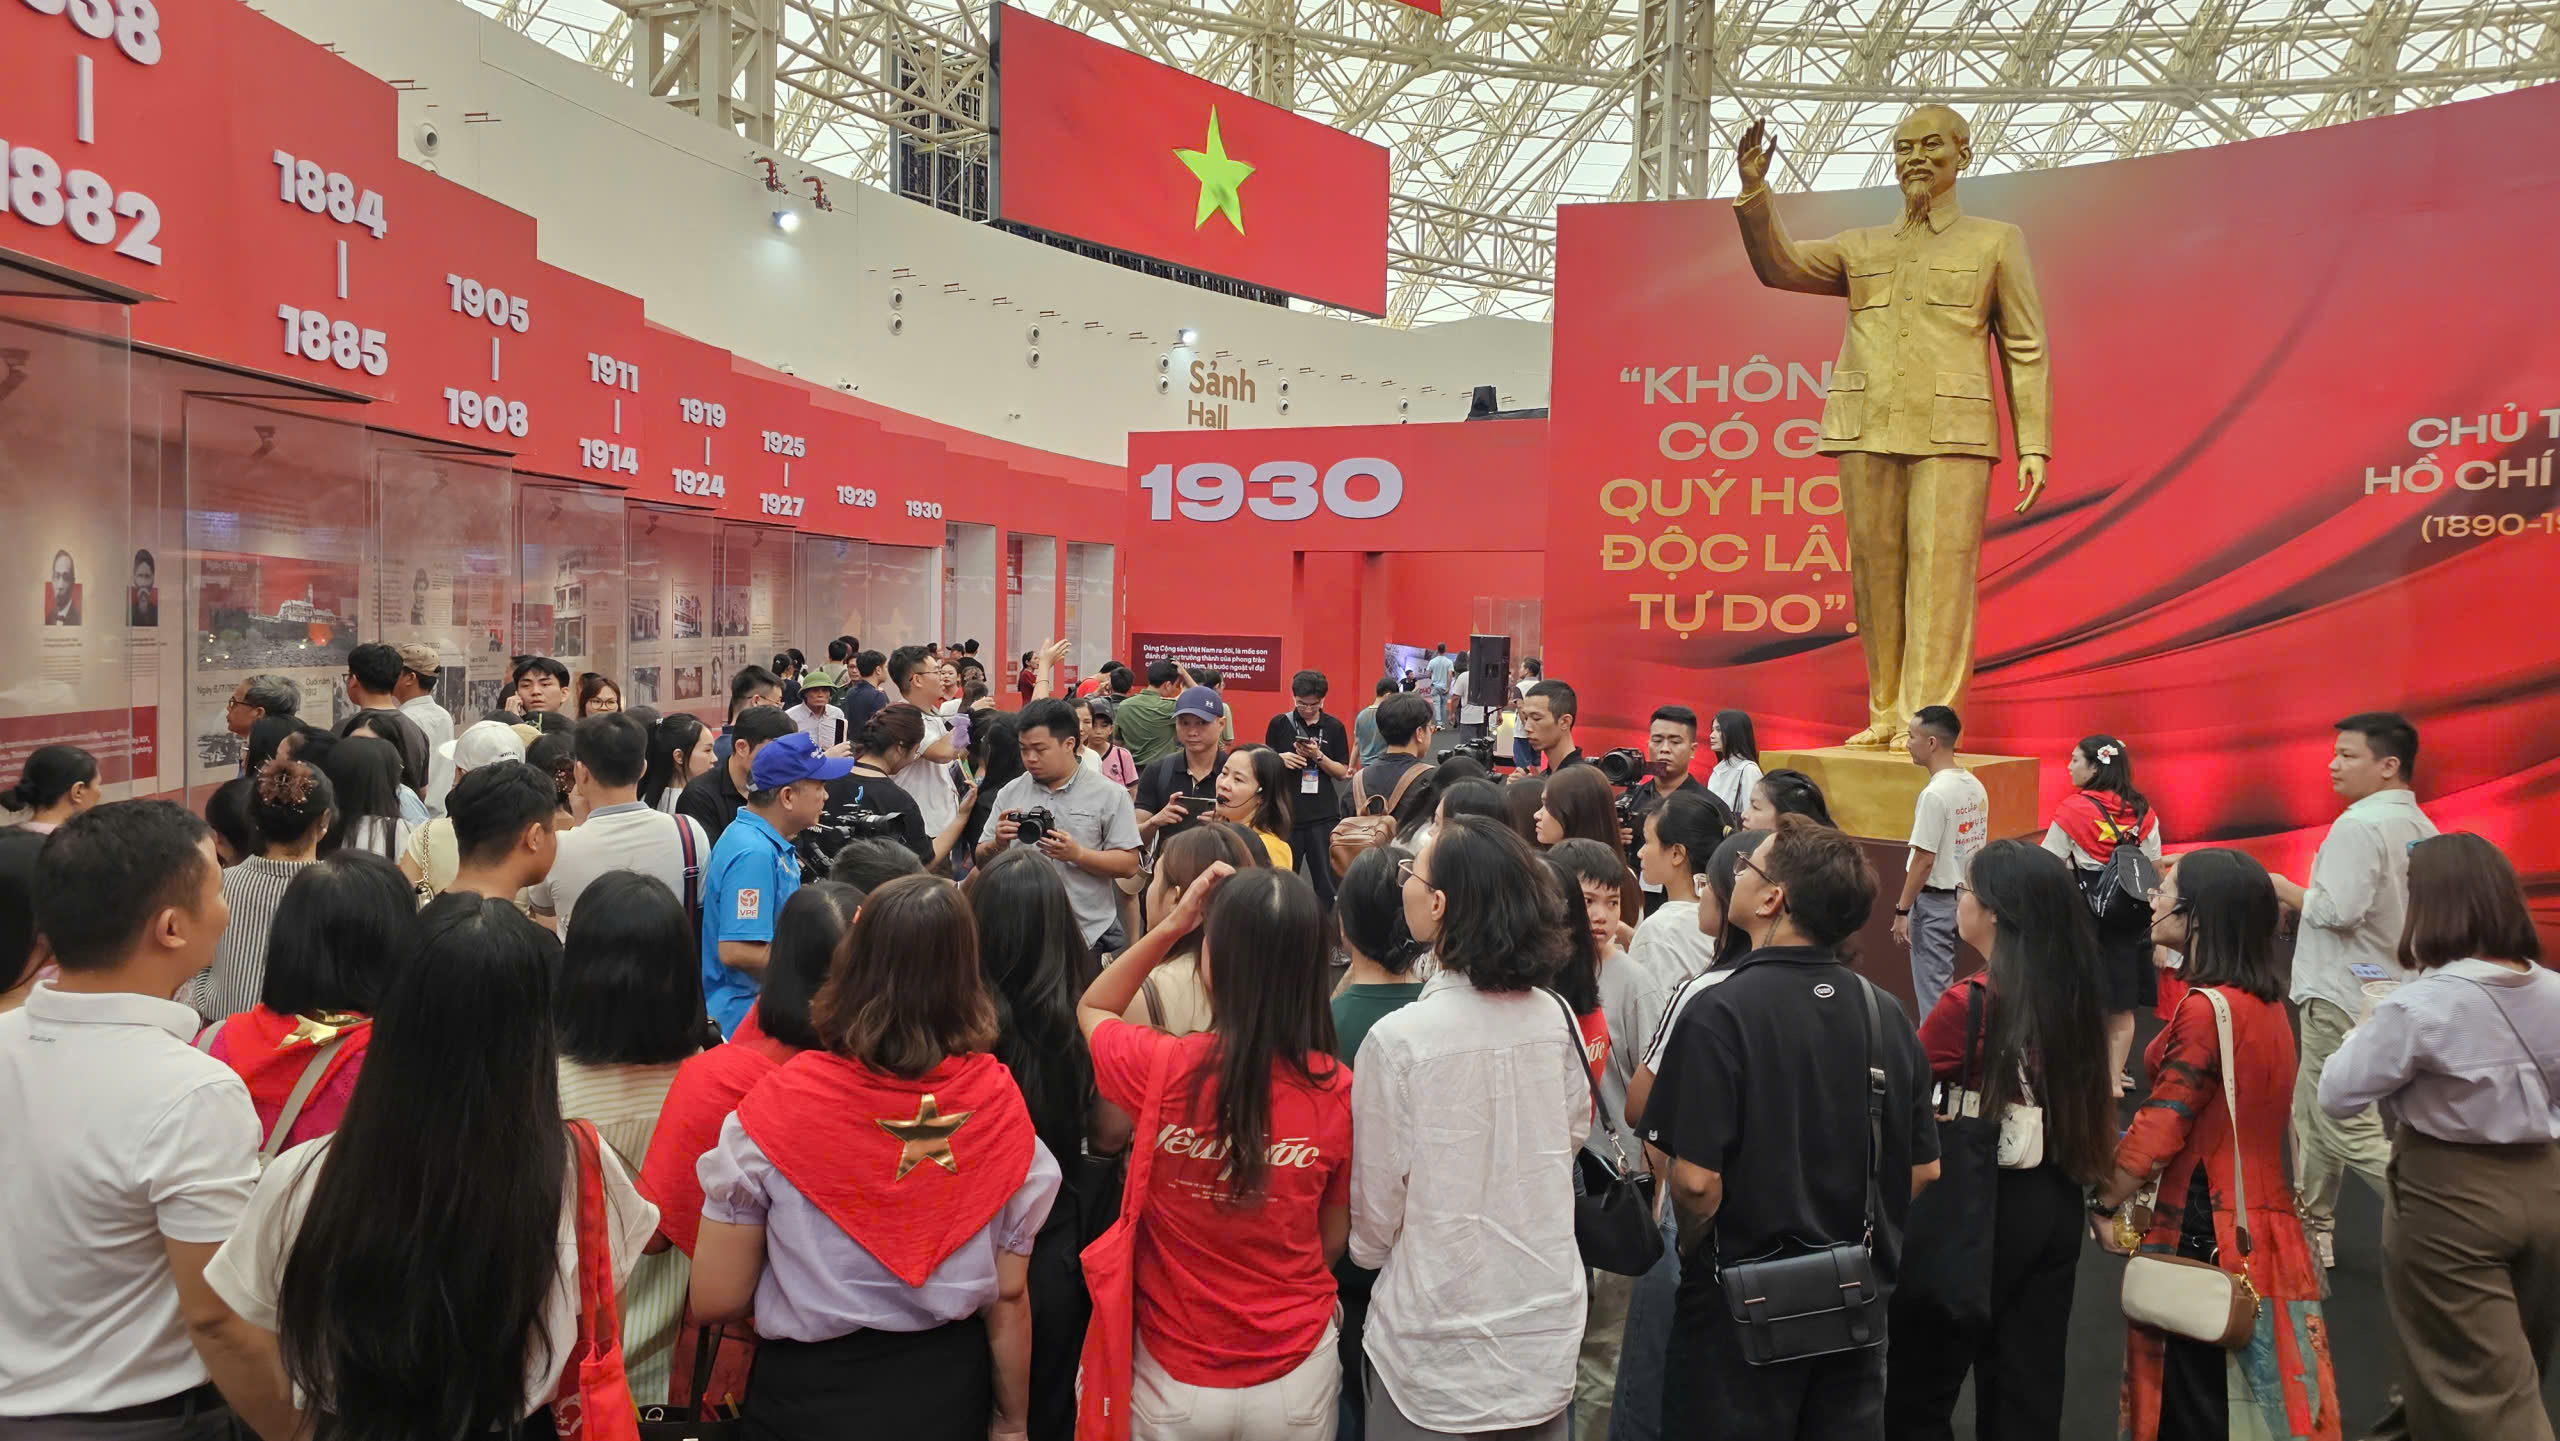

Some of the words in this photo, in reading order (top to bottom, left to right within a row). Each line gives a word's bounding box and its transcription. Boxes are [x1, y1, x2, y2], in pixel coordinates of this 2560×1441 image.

[273, 149, 387, 240] 1884
[446, 273, 530, 334] 1905
[277, 303, 388, 377] 1885
[587, 352, 639, 393] 1911
[1189, 360, 1256, 403] Sảnh
[1620, 354, 1833, 404] “KHÔN
[443, 387, 529, 438] 1908
[679, 397, 726, 428] 1919
[1188, 400, 1228, 430] Hall
[2408, 402, 2528, 448] CHỦ
[2539, 408, 2560, 438] T
[579, 437, 638, 475] 1914
[761, 430, 805, 458] 1925
[1659, 412, 1758, 461] CÓ
[1773, 419, 1821, 458] G
[671, 468, 725, 498] 1924
[1140, 457, 1404, 521] 1930
[2364, 453, 2444, 495] HỒ
[2455, 449, 2555, 490] CHÍ
[759, 493, 804, 517] 1927
[836, 485, 877, 508] 1929
[905, 500, 943, 520] 1930
[1600, 469, 1737, 524] QUÝ
[2421, 512, 2560, 543] (1890-1
[1600, 525, 1748, 581] ĐỘC
[1764, 524, 1852, 582] LẬ
[1629, 590, 1714, 640] TỰ
[1143, 644, 1159, 652] Đảng
[1160, 645, 1176, 653] Cộng
[1188, 646, 1200, 654] Việt
[1232, 656, 1252, 664] phong
[1255, 664, 1265, 672] đại
[740, 909, 757, 917] VPF
